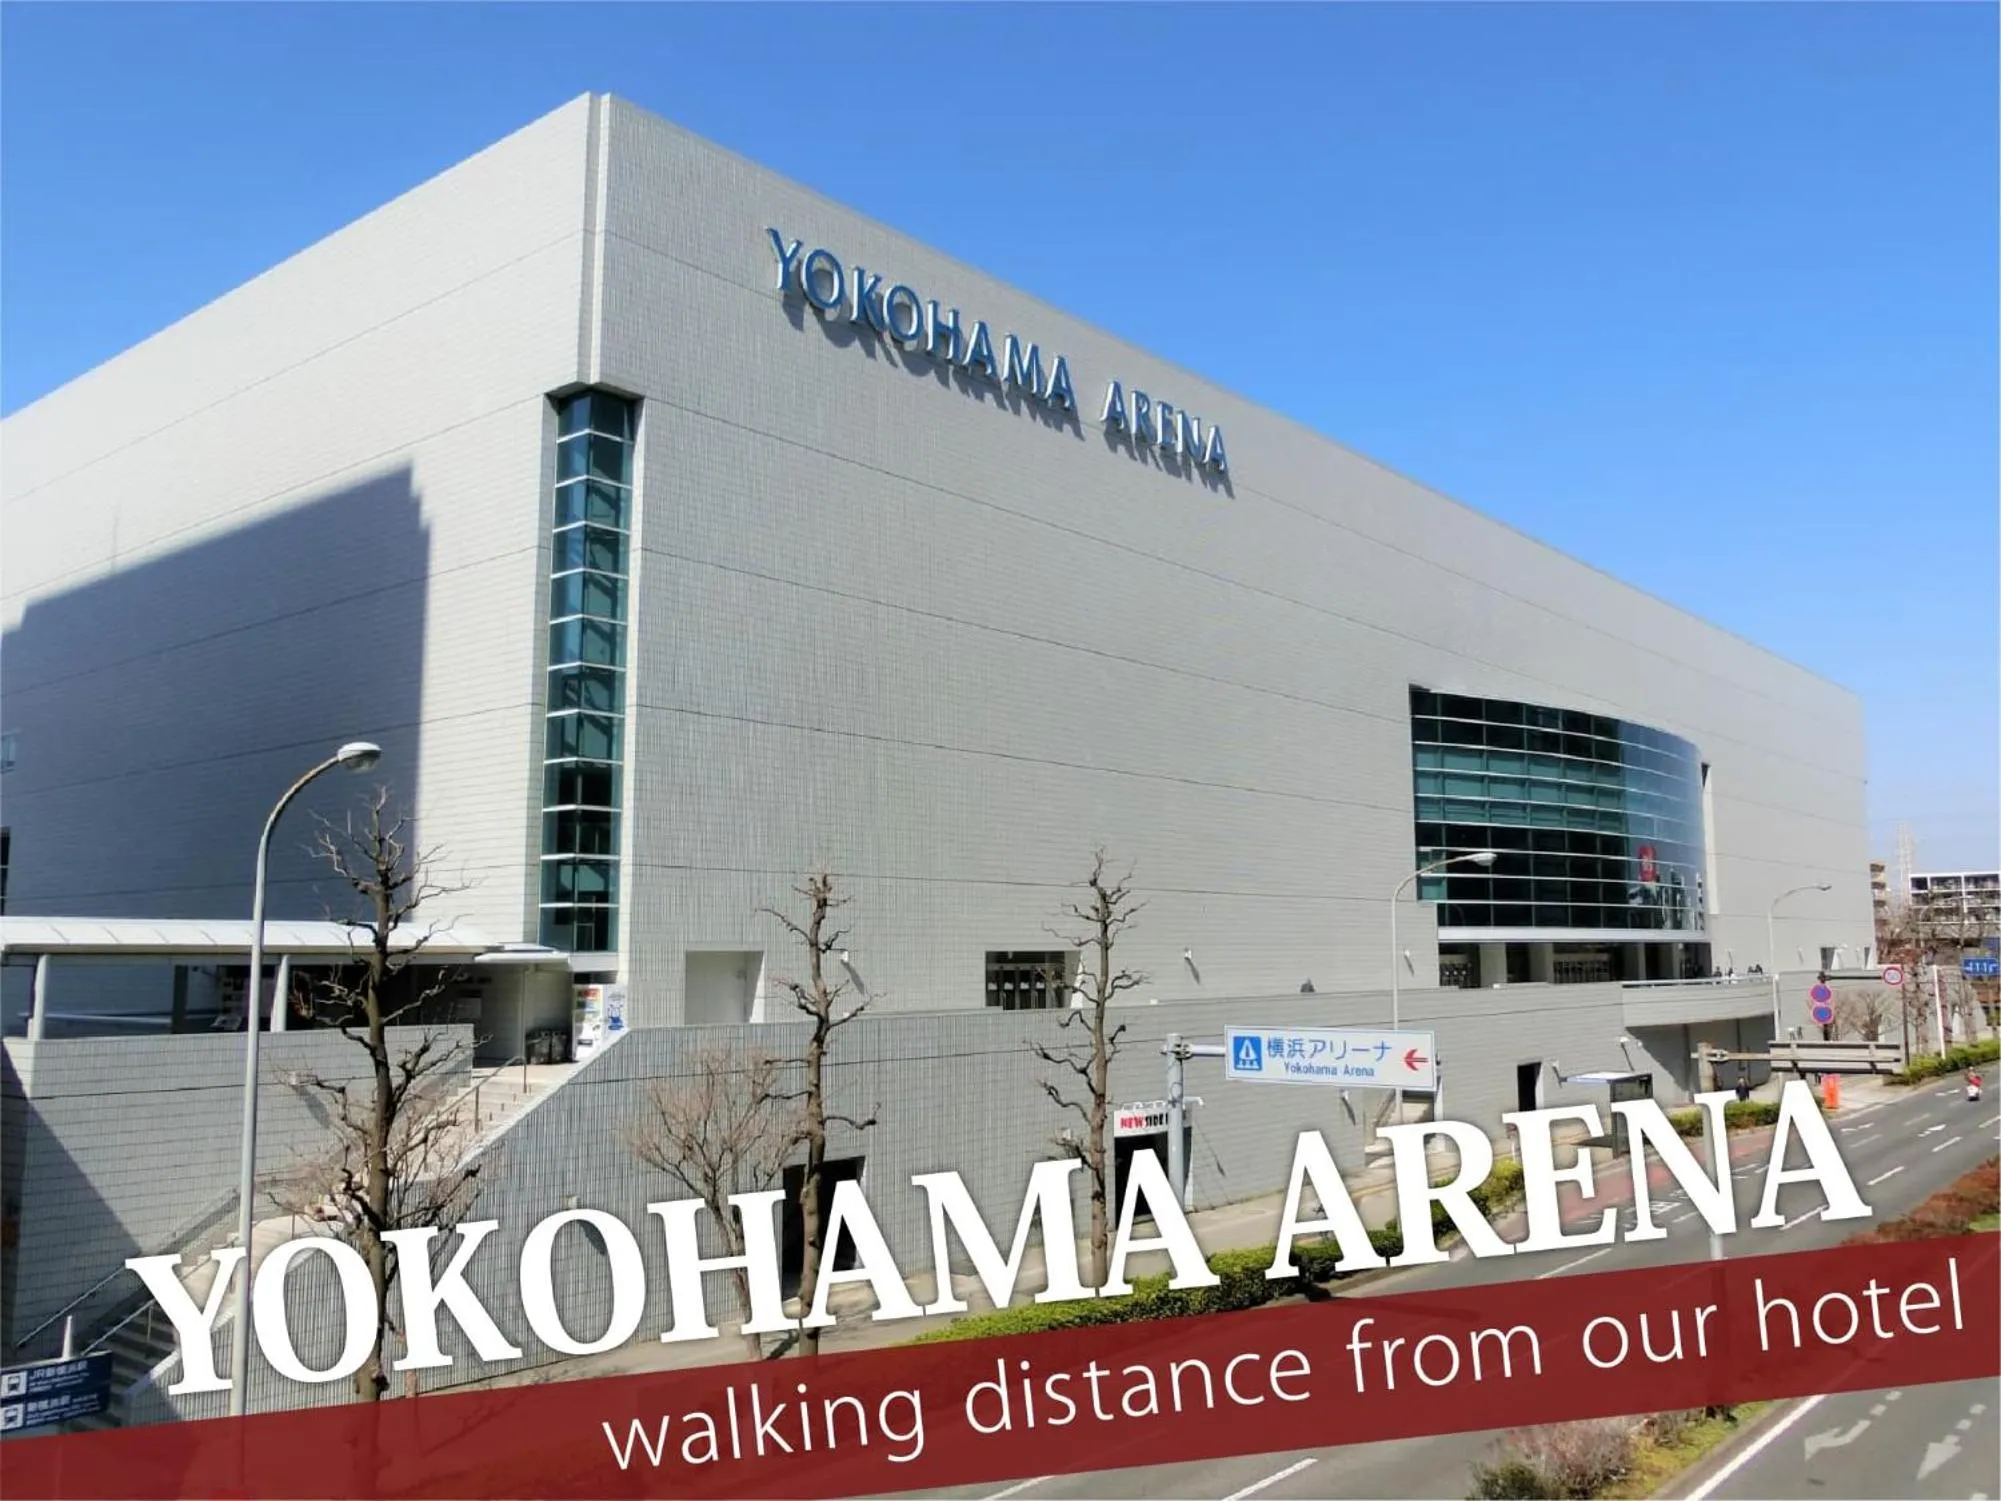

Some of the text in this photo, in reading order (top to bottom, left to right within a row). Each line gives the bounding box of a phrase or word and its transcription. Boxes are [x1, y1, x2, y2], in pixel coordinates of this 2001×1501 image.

[765, 226, 1227, 472] YOKOHAMA ARENA
[1266, 1036, 1392, 1062] 横浜アリーナ
[1283, 1061, 1375, 1078] Yokohama Arena
